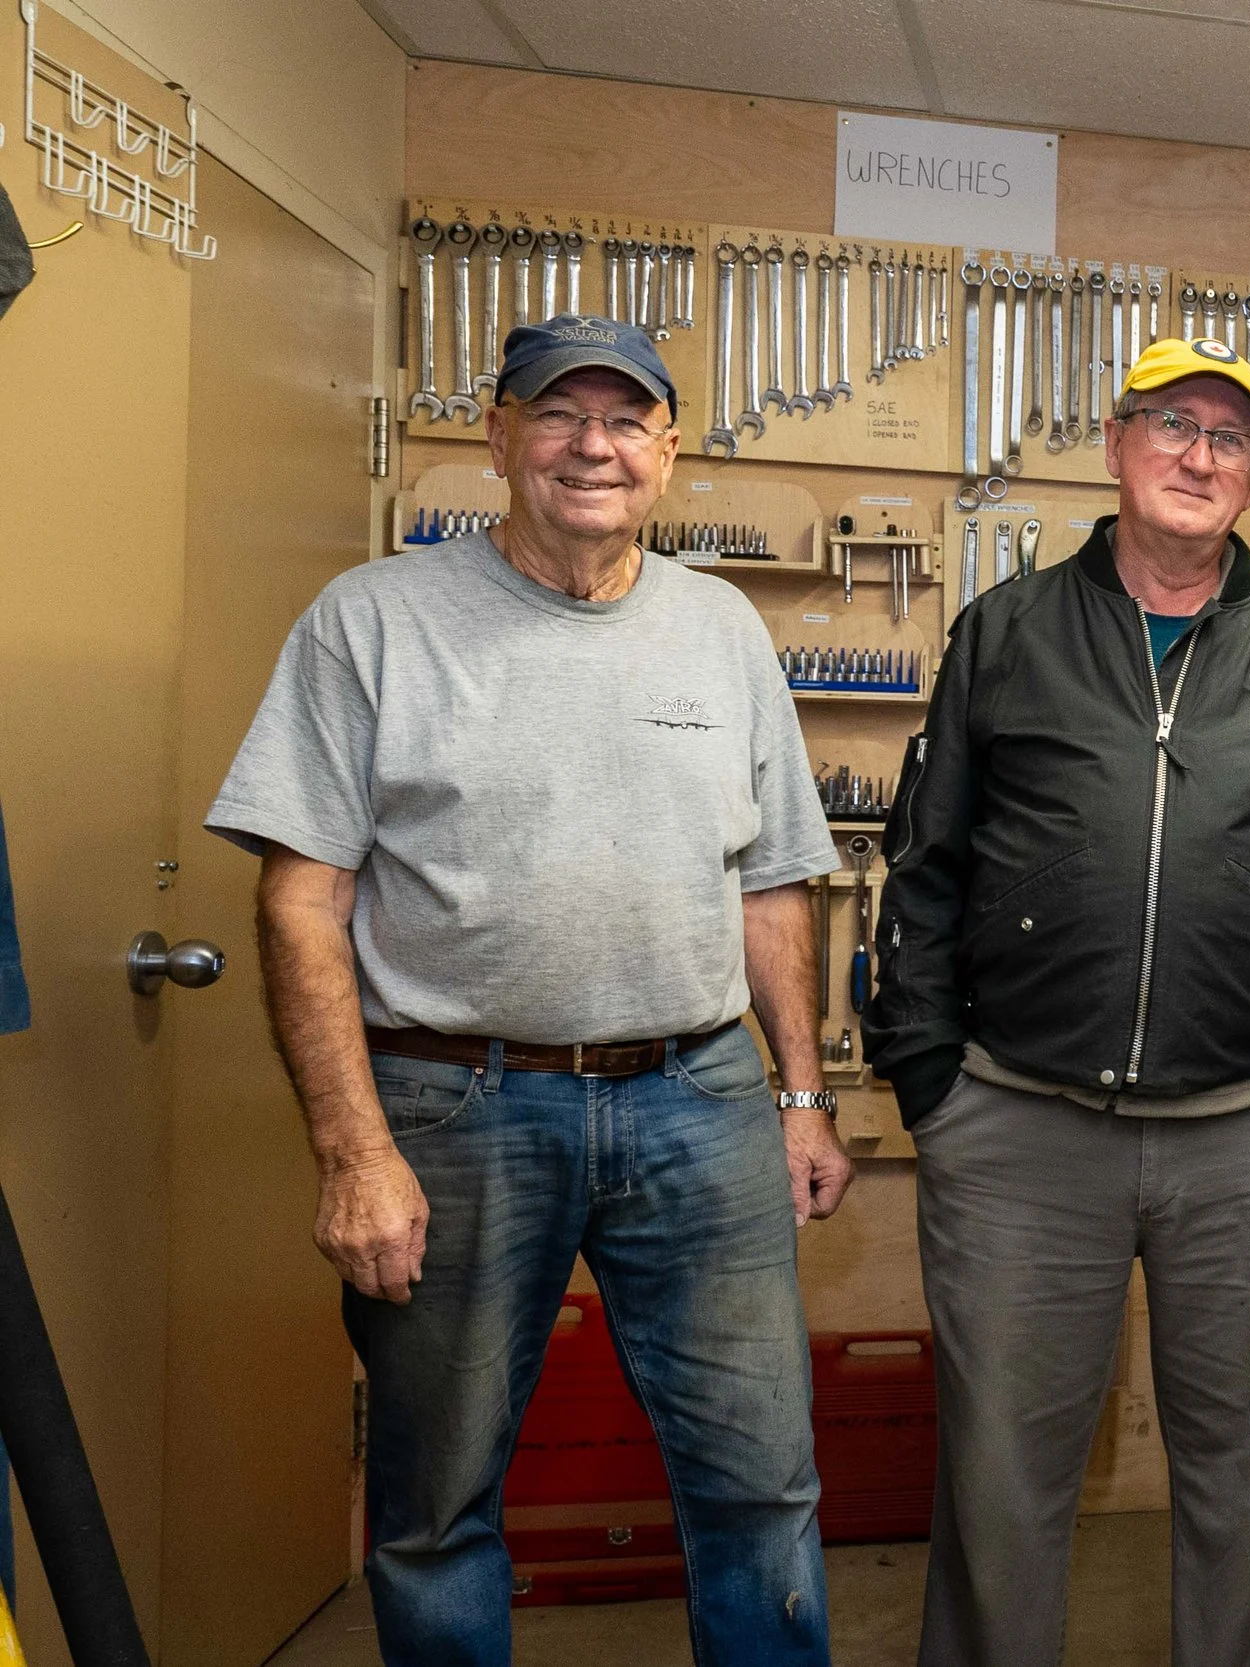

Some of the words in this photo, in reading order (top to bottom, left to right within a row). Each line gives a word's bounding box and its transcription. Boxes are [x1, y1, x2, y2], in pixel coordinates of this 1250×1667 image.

[847, 149, 1011, 198] WRENCHES
[1205, 280, 1215, 289] 18
[1225, 282, 1235, 292] 17
[866, 400, 896, 414] SAE
[872, 419, 900, 427] CLOSED
[903, 420, 920, 428] END
[872, 431, 898, 439] OPENED
[903, 432, 917, 440] END
